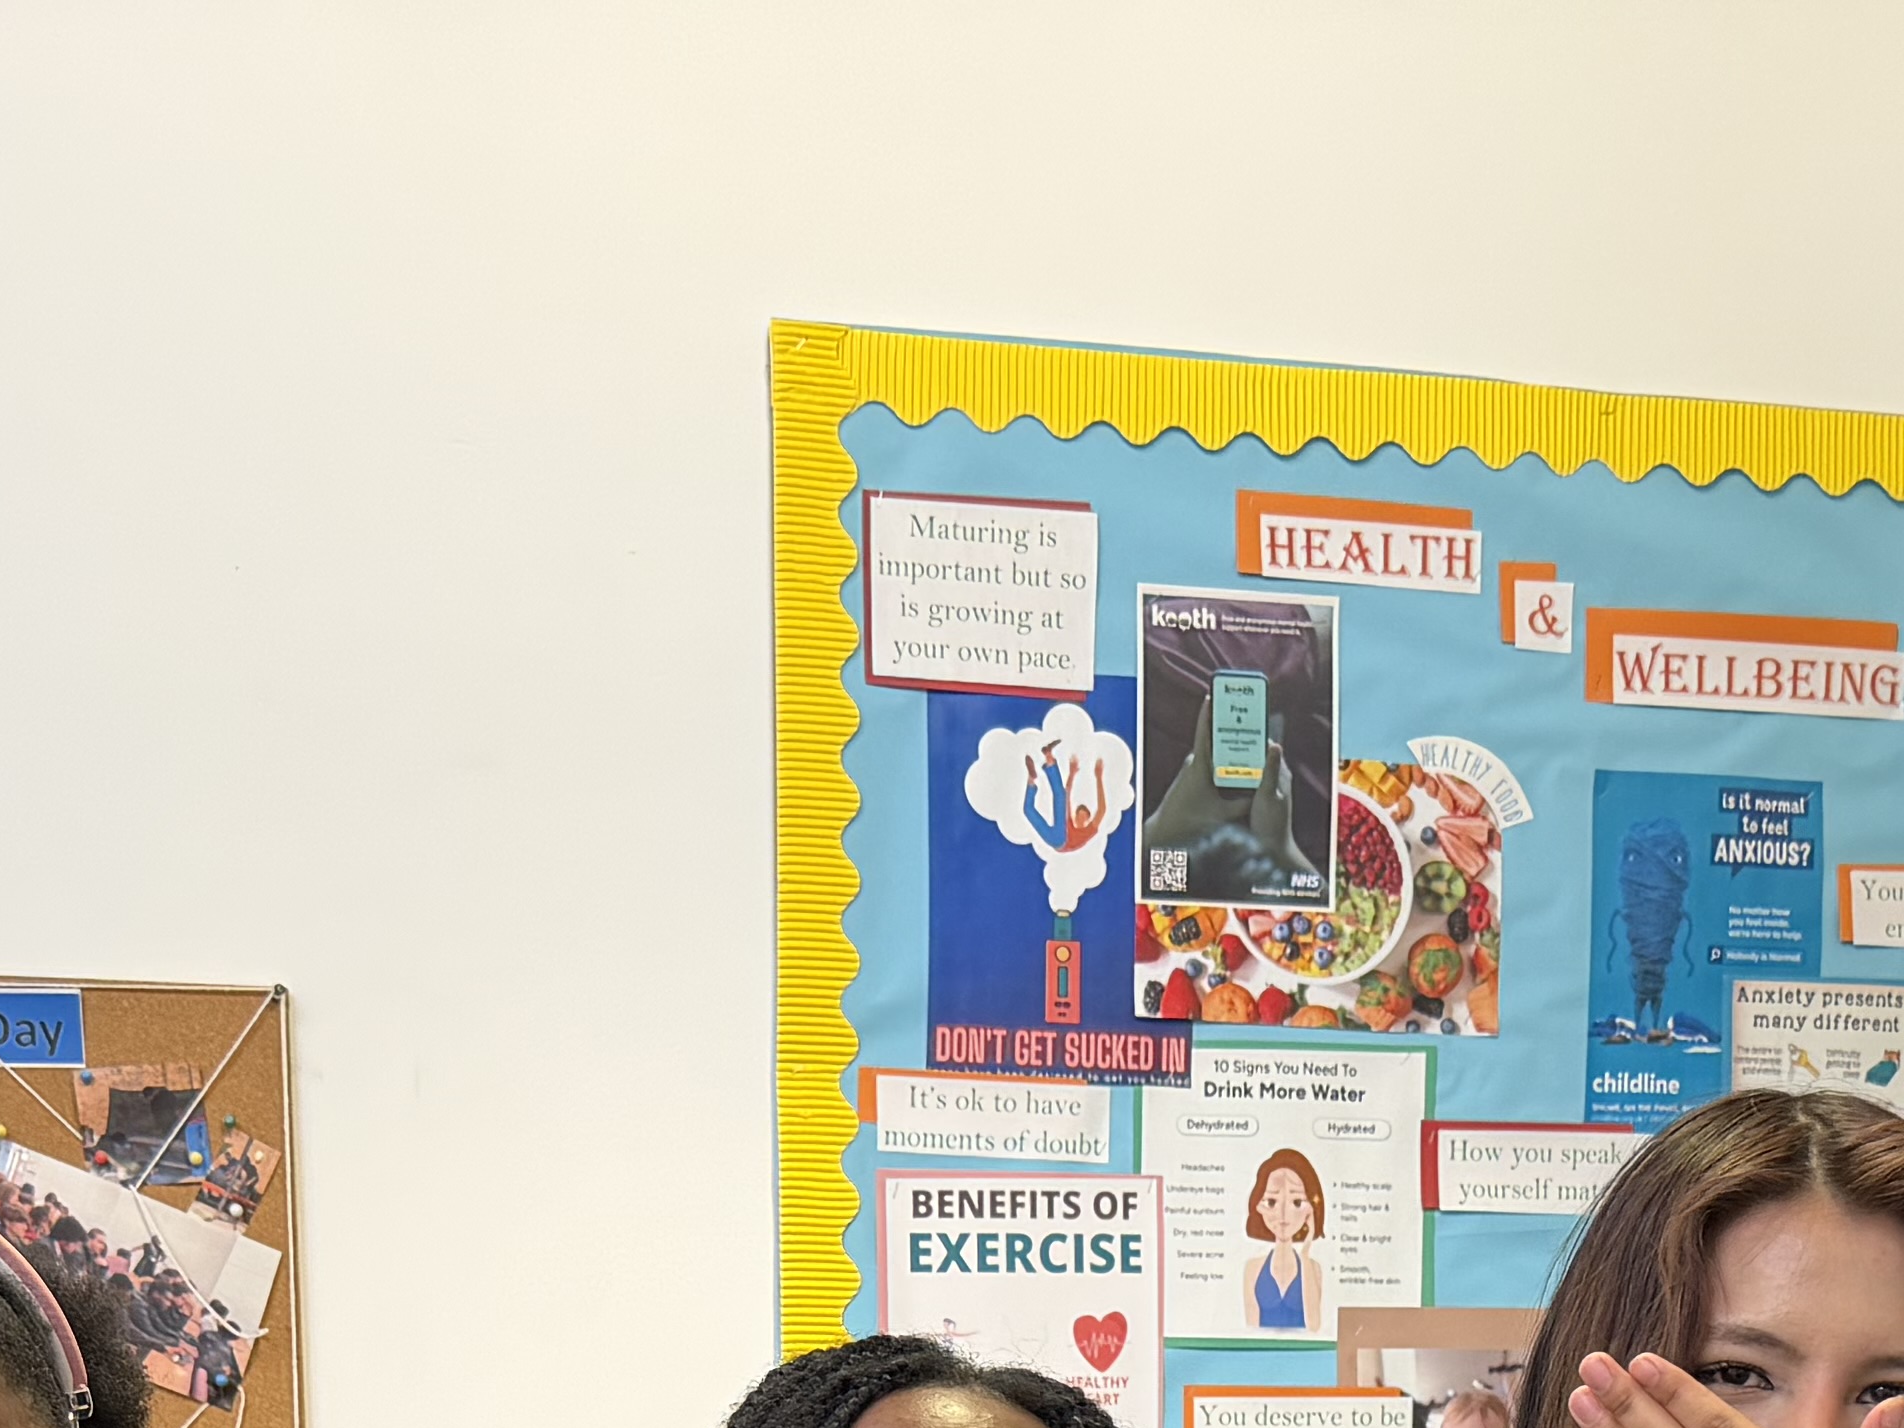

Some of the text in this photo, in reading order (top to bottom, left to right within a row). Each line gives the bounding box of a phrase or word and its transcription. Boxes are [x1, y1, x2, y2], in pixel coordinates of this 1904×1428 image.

[910, 514, 1057, 553] Maturing is
[1266, 525, 1478, 582] HEALTH
[878, 552, 1087, 590] important but so
[900, 594, 1064, 635] is growing at
[1151, 604, 1216, 631] kooth
[1528, 594, 1569, 638] &
[893, 640, 949, 664] your
[958, 646, 1009, 665] own
[1616, 642, 1901, 708] WELLBEING
[1418, 742, 1525, 824] HEALTHY FOOD
[1739, 792, 1751, 810] it
[1755, 796, 1805, 814] normal
[1742, 816, 1789, 836] to feel
[1713, 837, 1812, 867] ANXIOUS?
[1737, 987, 1816, 1007] Anxiety
[1822, 990, 1903, 1012] presents
[1753, 1013, 1807, 1033] many
[1814, 1013, 1899, 1032] different
[935, 1026, 1185, 1074] DON'T GET SUCKED IN
[1213, 1059, 1357, 1078] 10 Signs You Need To
[1204, 1081, 1366, 1103] Drink More Water
[1592, 1072, 1681, 1096] childline
[909, 1085, 1081, 1116] It's ok to have
[1187, 1119, 1249, 1131] Dehydrated
[1328, 1123, 1376, 1135] Hydrated
[884, 1130, 1102, 1156] moments of doubt
[1449, 1140, 1622, 1170] How you speak
[1181, 1164, 1225, 1172] Headaches
[1458, 1178, 1602, 1204] yourself mat
[911, 1190, 1138, 1220] BENEFITS OF
[909, 1232, 1142, 1274] EXERCISE
[1065, 1376, 1129, 1389] HEALTHY
[1199, 1404, 1406, 1427] You deserve to be
